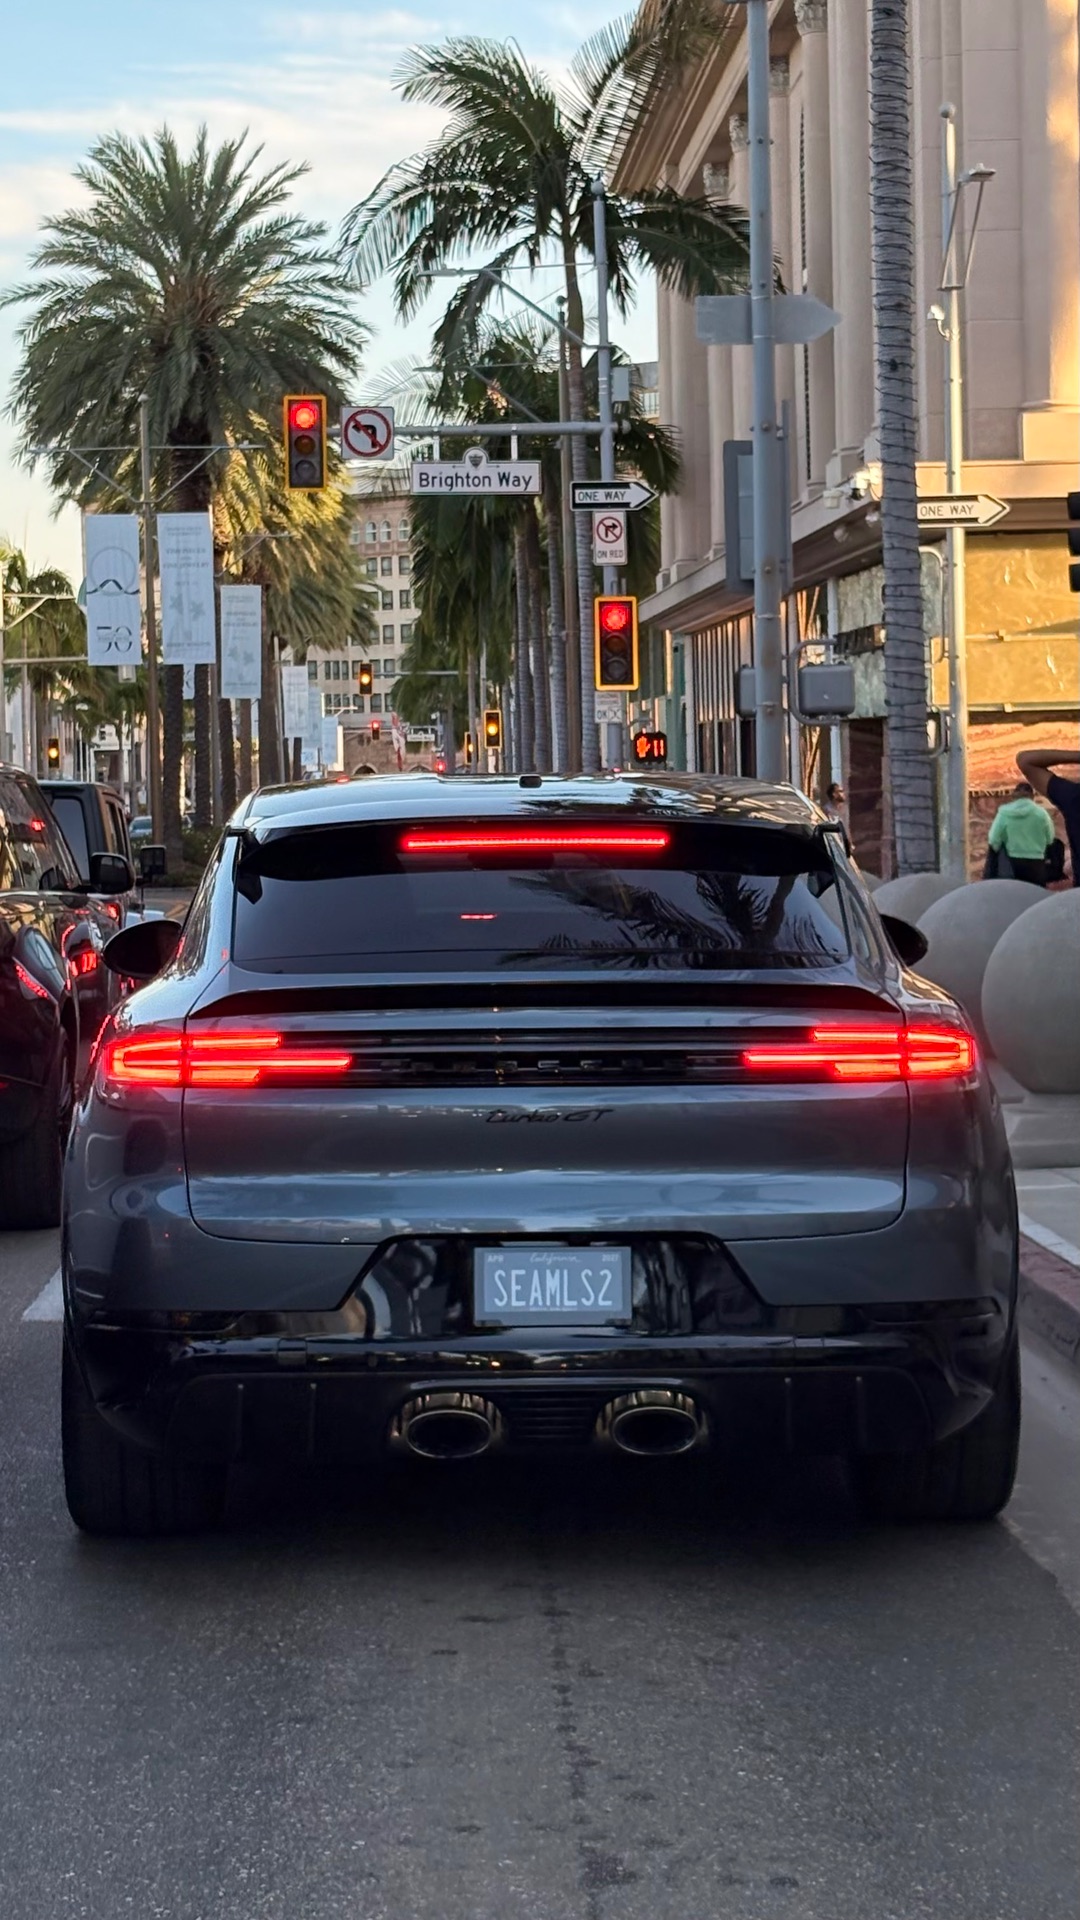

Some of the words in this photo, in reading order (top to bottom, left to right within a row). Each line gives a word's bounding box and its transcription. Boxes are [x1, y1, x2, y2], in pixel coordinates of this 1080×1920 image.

[419, 471, 492, 492] Brighton
[497, 471, 533, 491] Way
[578, 491, 600, 501] ONE
[604, 490, 626, 501] WAY
[920, 505, 944, 517] ONE
[949, 504, 974, 516] WAY
[597, 550, 608, 559] ON
[609, 550, 624, 559] RED
[653, 739, 664, 757] 11
[563, 1108, 614, 1122] GT
[487, 1254, 504, 1263] APR
[529, 1252, 582, 1265] California
[494, 1268, 613, 1307] SEAMLS2
